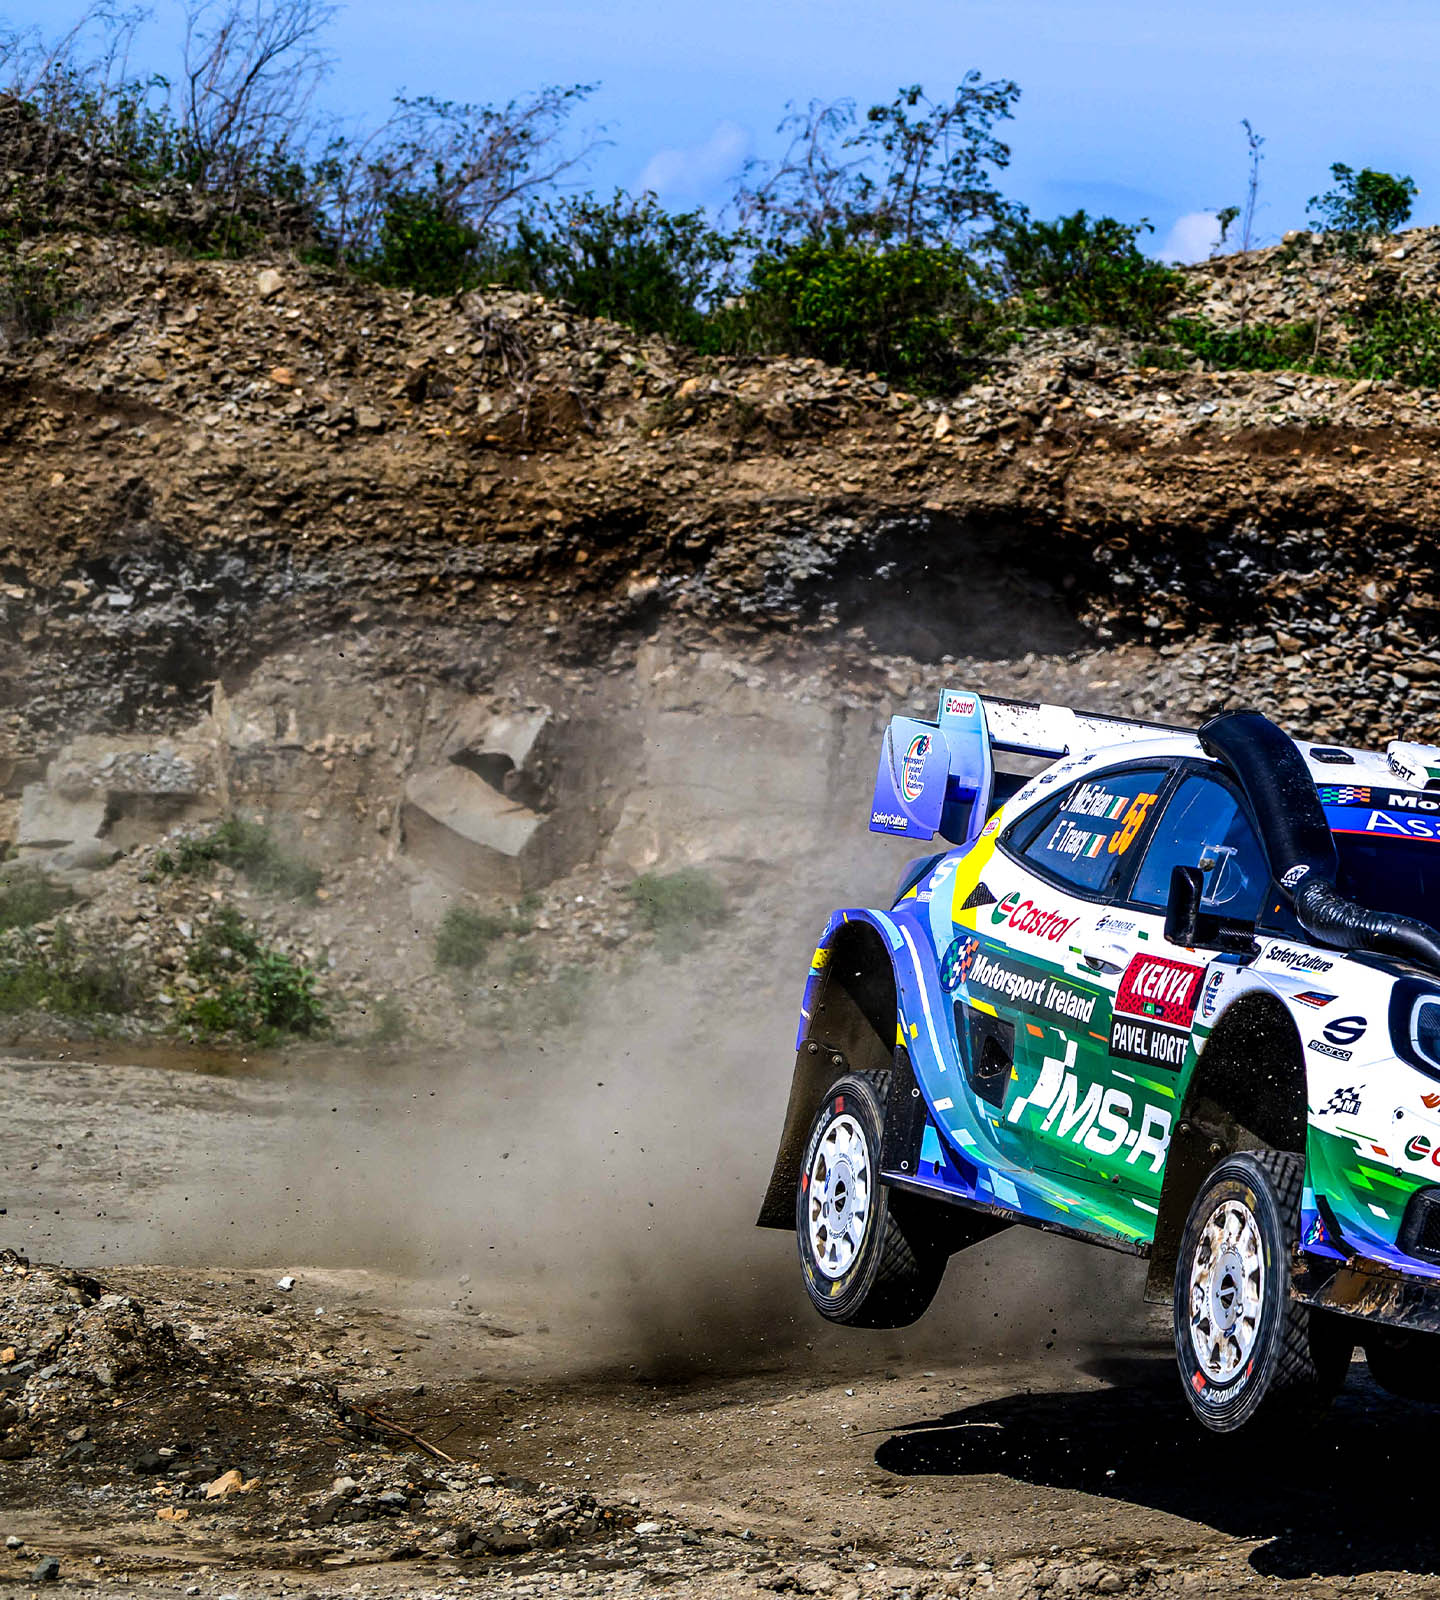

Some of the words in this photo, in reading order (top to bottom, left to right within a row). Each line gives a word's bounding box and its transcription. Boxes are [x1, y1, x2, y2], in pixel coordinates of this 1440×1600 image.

[951, 699, 976, 715] Castrol
[1060, 781, 1080, 811] J
[1068, 783, 1114, 818] McErlean
[872, 812, 908, 827] SafetyCulture
[1046, 820, 1068, 850] E
[1107, 792, 1158, 856] 55
[1056, 821, 1093, 862] Treacy
[1008, 900, 1081, 943] Castrol
[1266, 946, 1334, 972] SafetyCulture
[968, 953, 1048, 1004] Motorsport
[1044, 982, 1097, 1023] Ireland
[1131, 962, 1195, 1006] KENYA
[1112, 1022, 1148, 1056] PAVEL
[1310, 1040, 1351, 1061] sparco
